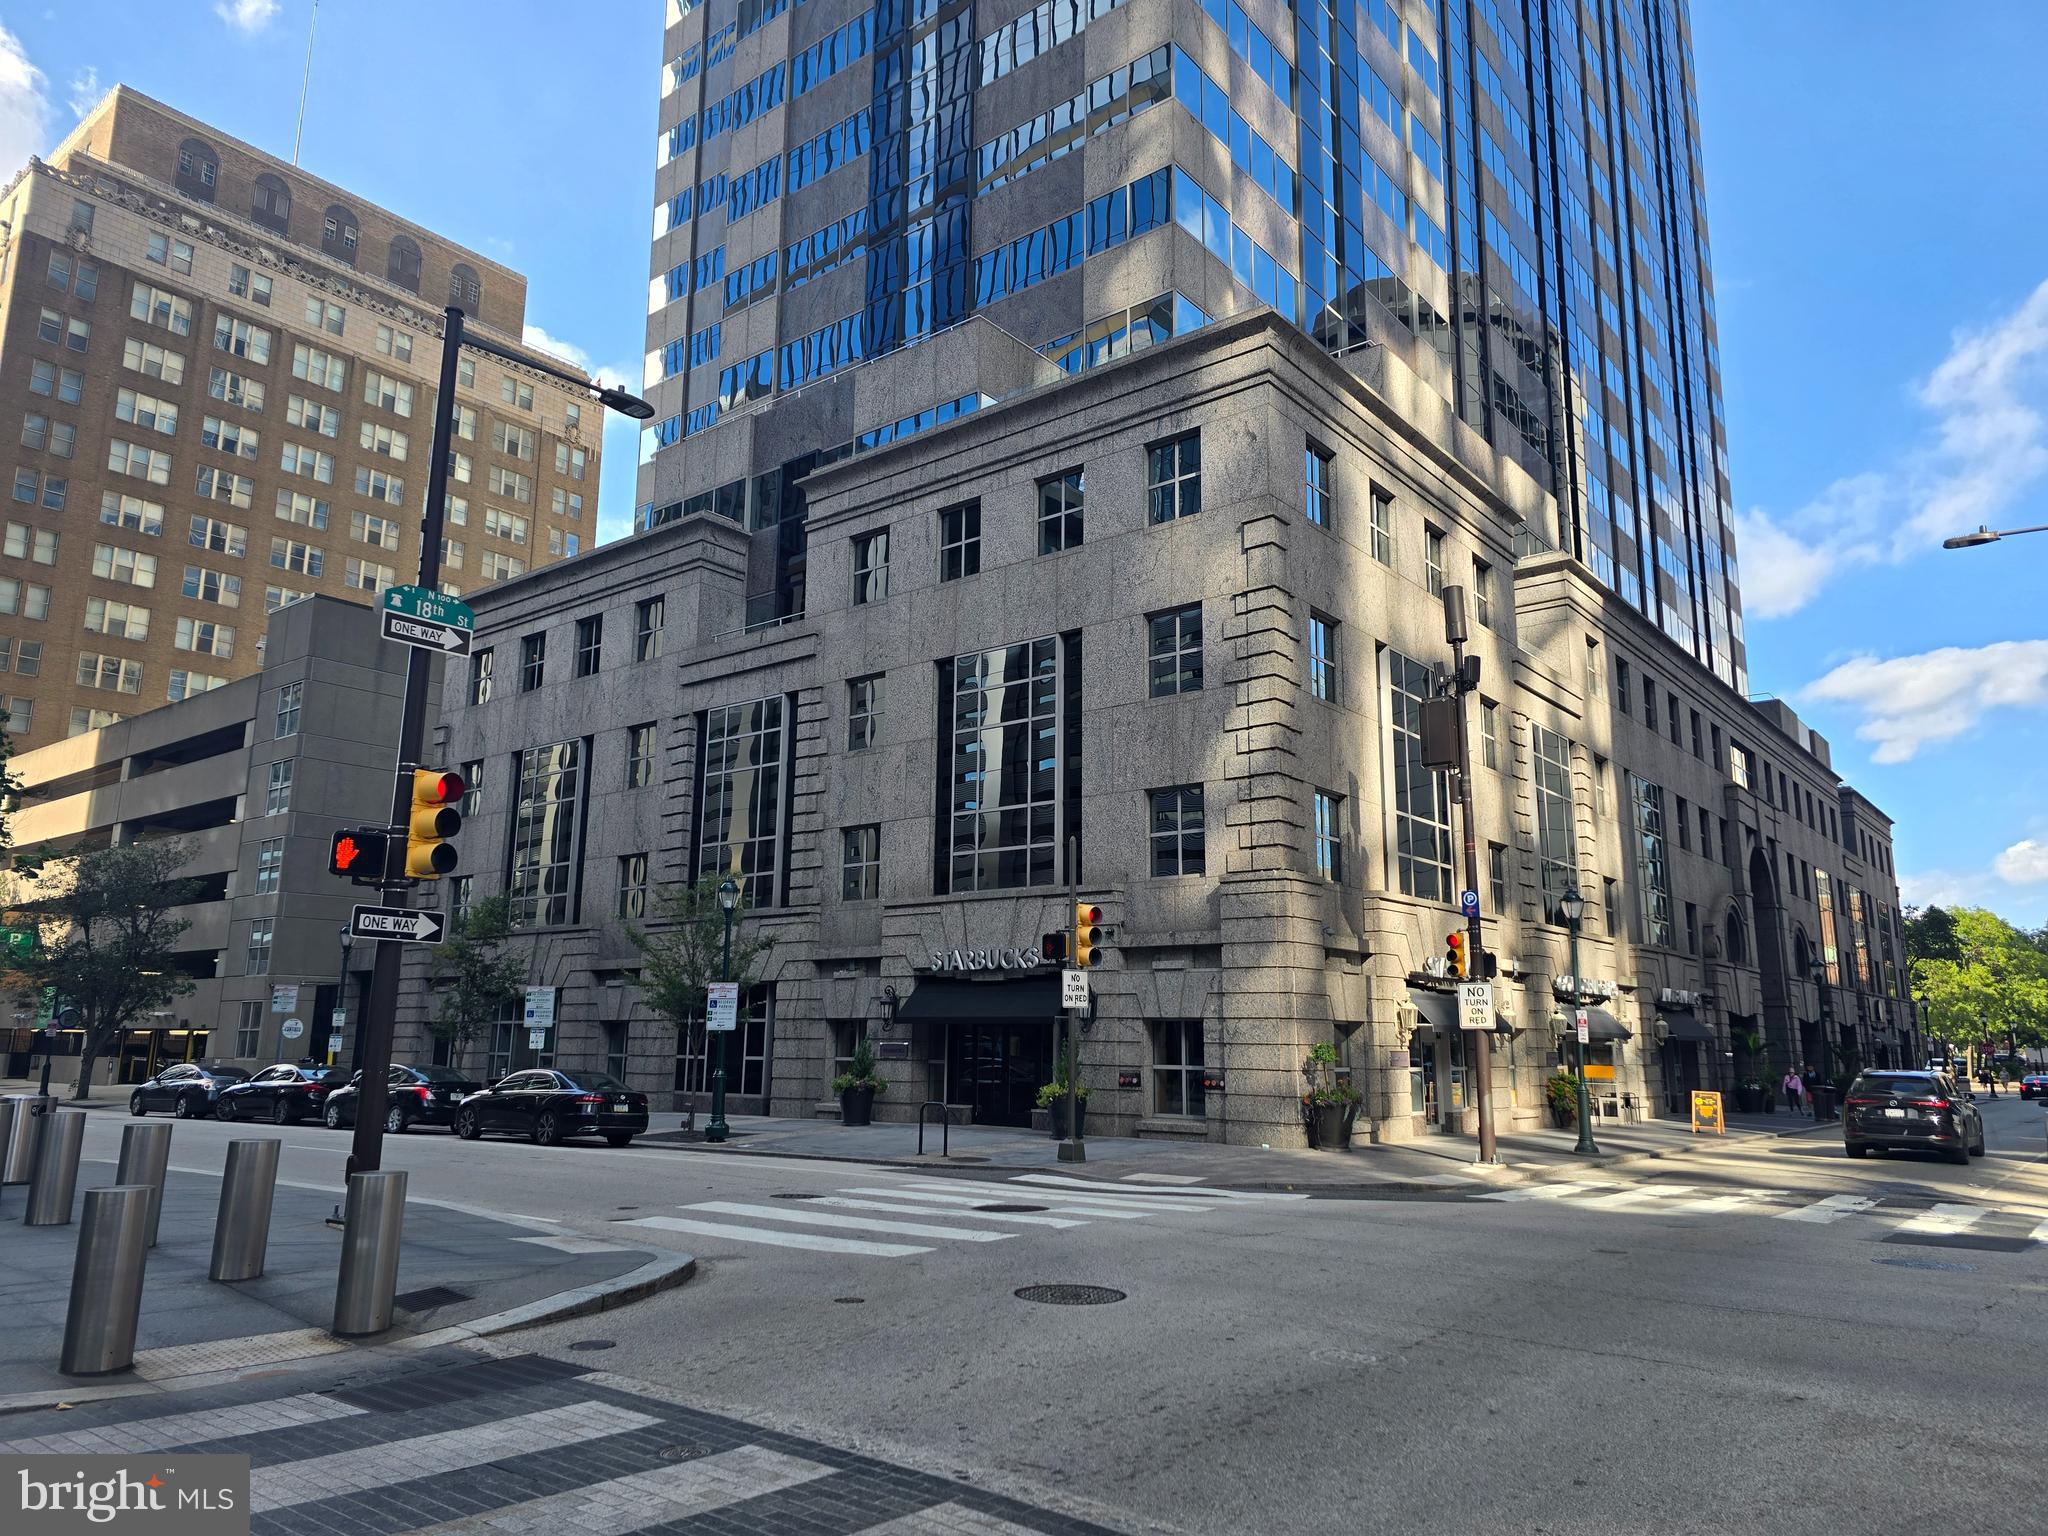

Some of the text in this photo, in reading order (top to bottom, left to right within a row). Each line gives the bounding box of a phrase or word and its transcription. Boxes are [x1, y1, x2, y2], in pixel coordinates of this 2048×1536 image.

[428, 590, 435, 600] N
[437, 594, 451, 603] 100
[416, 599, 444, 618] 18th
[457, 615, 469, 628] St
[394, 621, 443, 641] ONE WAY
[1467, 895, 1475, 903] P
[362, 915, 418, 932] ONE WAY
[930, 947, 1040, 971] STARBUCKS
[1071, 974, 1081, 983] NO
[1067, 984, 1085, 992] TURN
[1467, 987, 1485, 997] NO
[1064, 994, 1088, 1003] ON RED
[1465, 998, 1488, 1006] TURN
[1471, 1007, 1484, 1015] ON
[1469, 1016, 1487, 1024] RED
